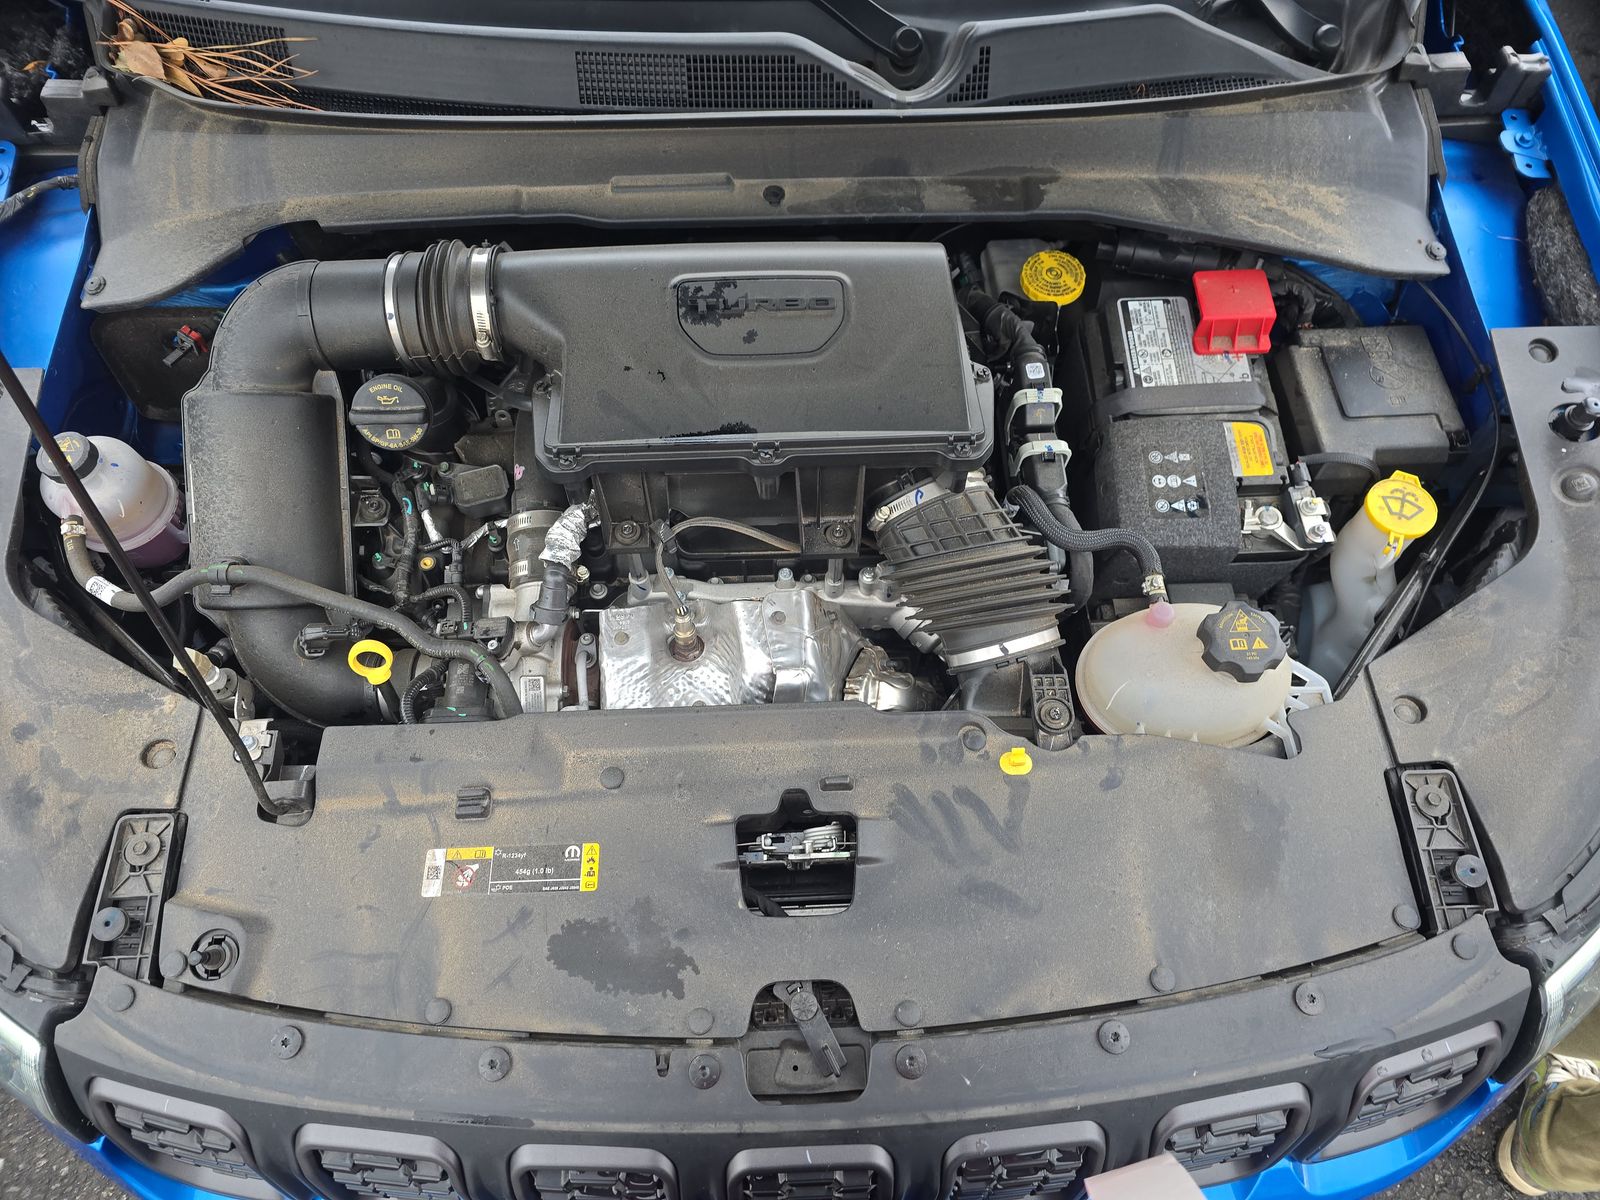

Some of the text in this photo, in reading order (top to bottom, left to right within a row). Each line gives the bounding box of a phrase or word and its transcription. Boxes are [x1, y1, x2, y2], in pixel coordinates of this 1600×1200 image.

[686, 296, 836, 315] TURBO
[369, 383, 403, 394] ENGINE OIL
